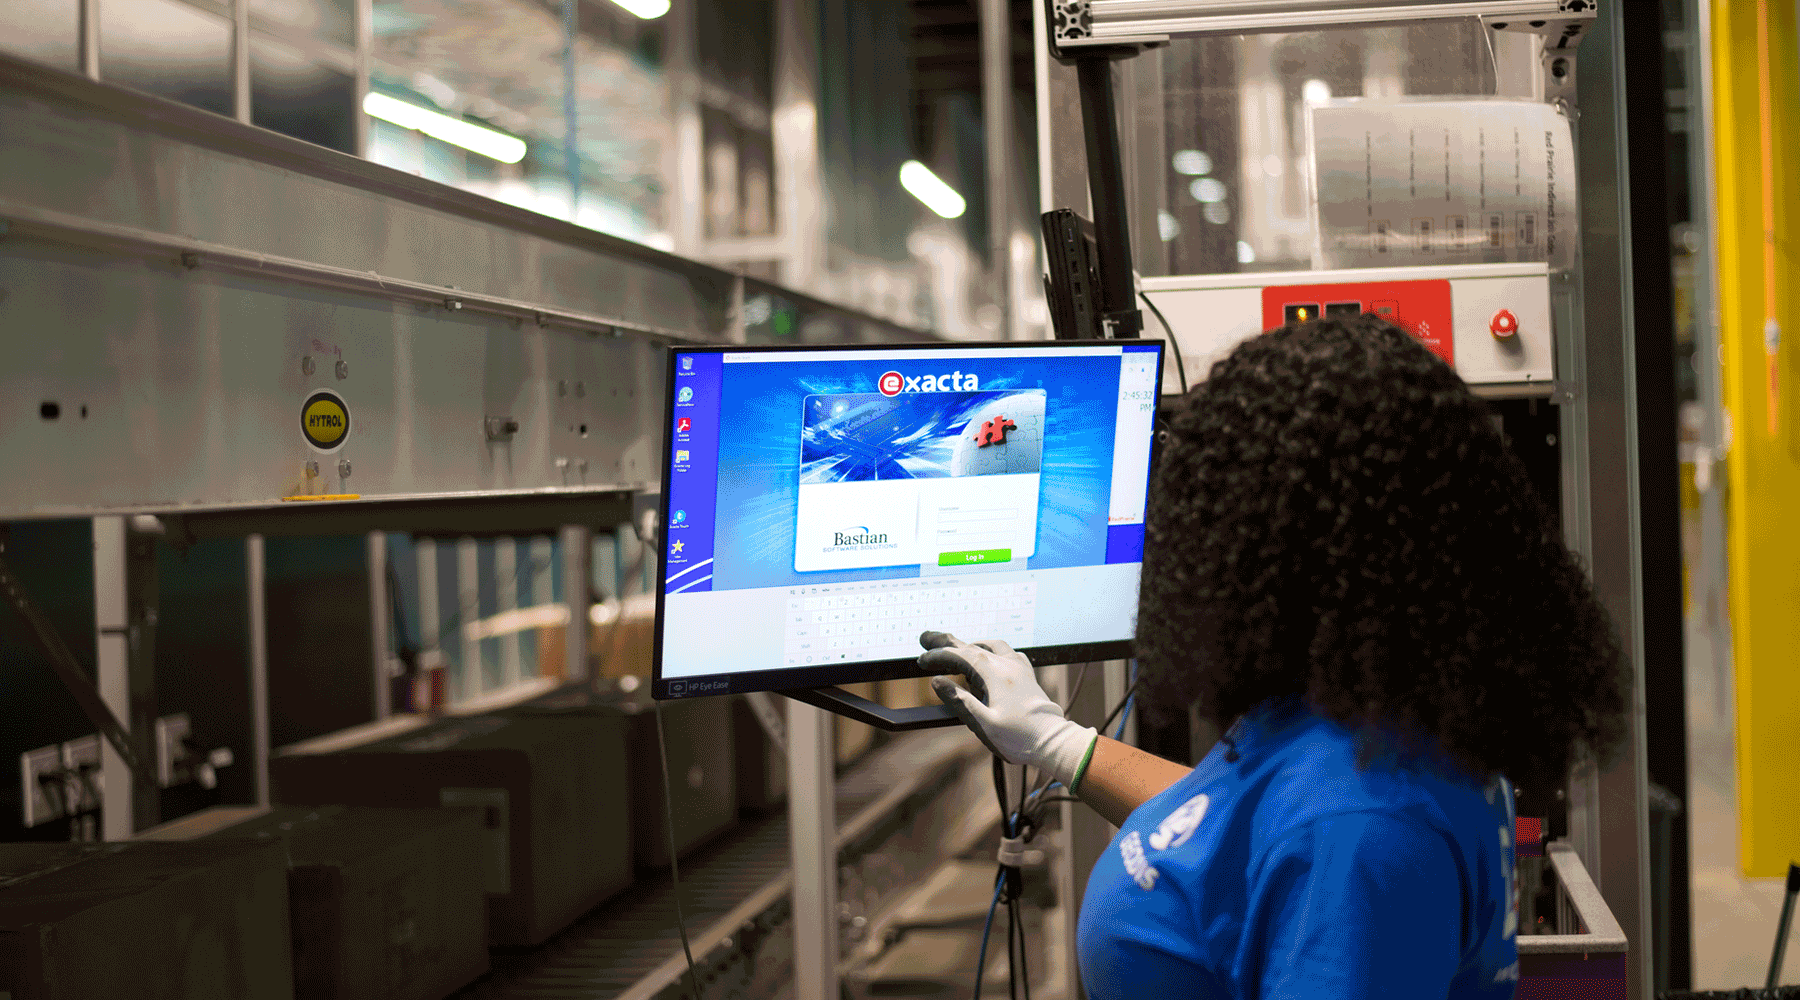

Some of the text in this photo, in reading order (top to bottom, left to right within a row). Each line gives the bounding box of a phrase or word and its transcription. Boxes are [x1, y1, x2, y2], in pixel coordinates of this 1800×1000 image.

[879, 370, 979, 396] exacta
[1122, 391, 1153, 400] 2:45:32
[1140, 403, 1152, 412] PM
[309, 414, 342, 427] HYTROL
[834, 532, 888, 546] Bastian
[823, 543, 898, 553] SOFTWARE SOLUTIONS
[965, 554, 977, 562] Log
[689, 681, 729, 691] HP Eye Ease
